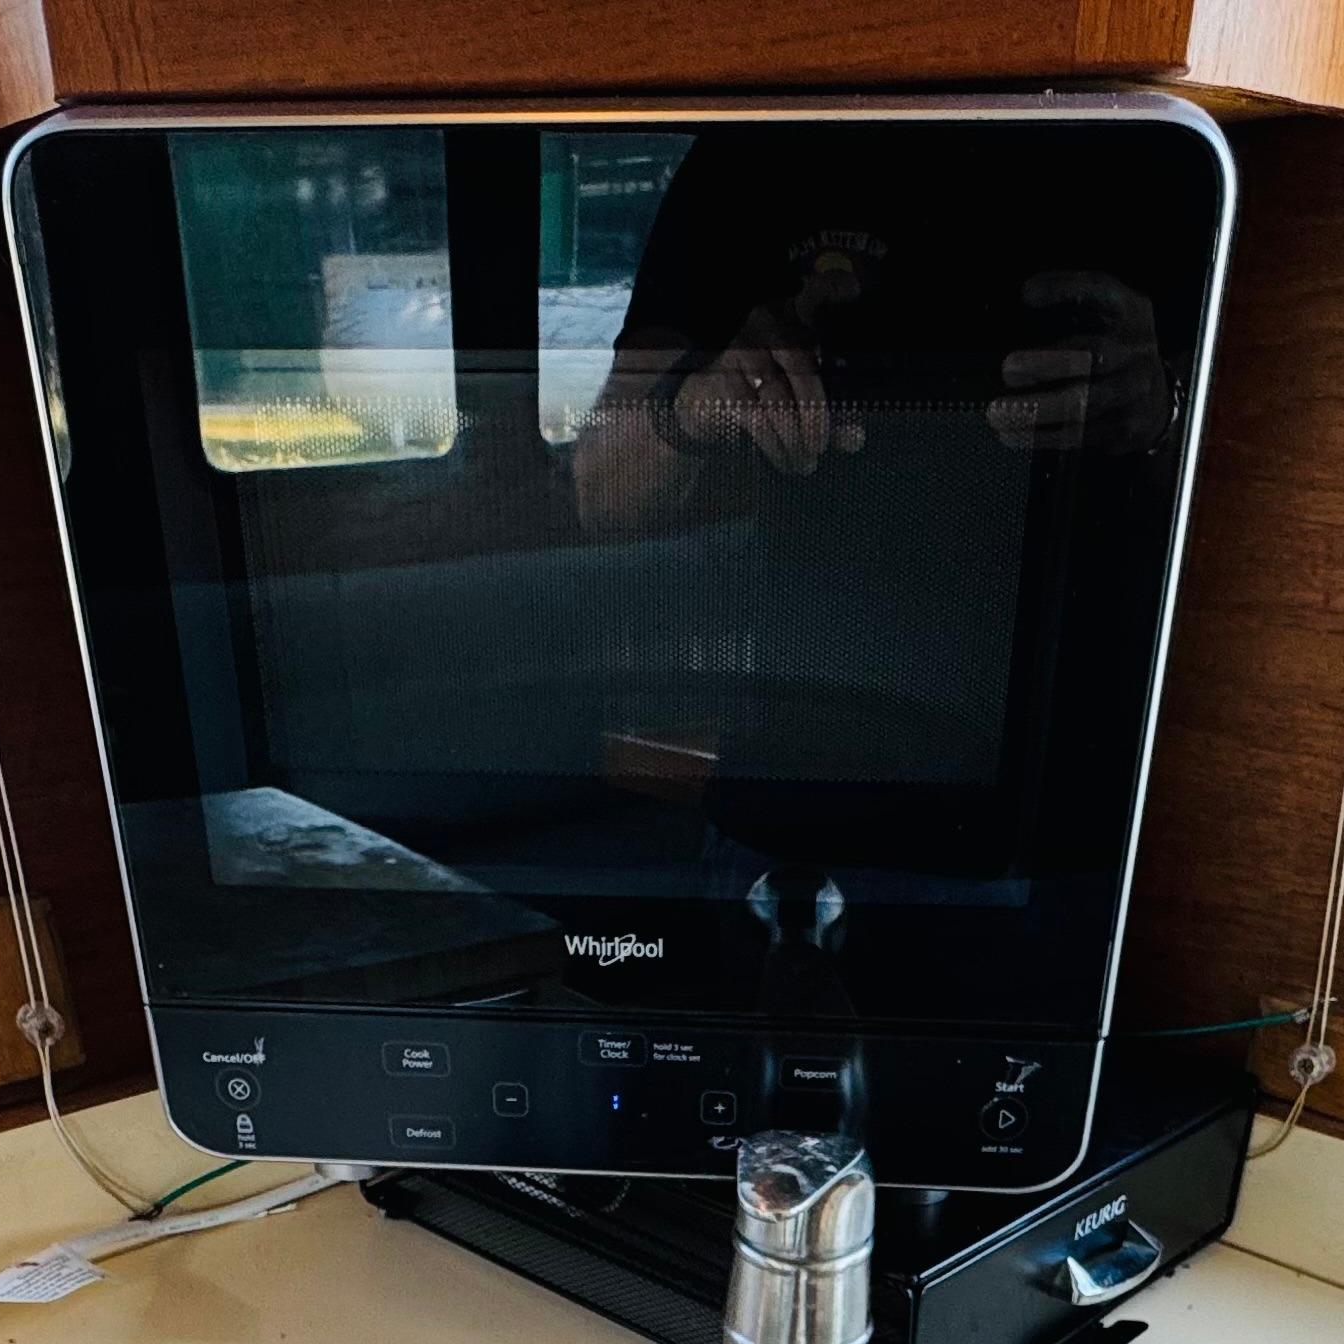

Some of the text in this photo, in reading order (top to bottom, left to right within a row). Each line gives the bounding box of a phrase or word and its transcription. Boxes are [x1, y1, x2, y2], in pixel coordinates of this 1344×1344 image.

[564, 934, 664, 966] Whirlpool
[598, 1039, 632, 1049] Timer/
[404, 1048, 430, 1059] Cook
[599, 1049, 630, 1059] Clock
[402, 1058, 433, 1069] Power
[995, 1081, 1024, 1092] Start
[406, 1127, 441, 1138] Defrost
[1074, 1194, 1128, 1240] KEURIG
